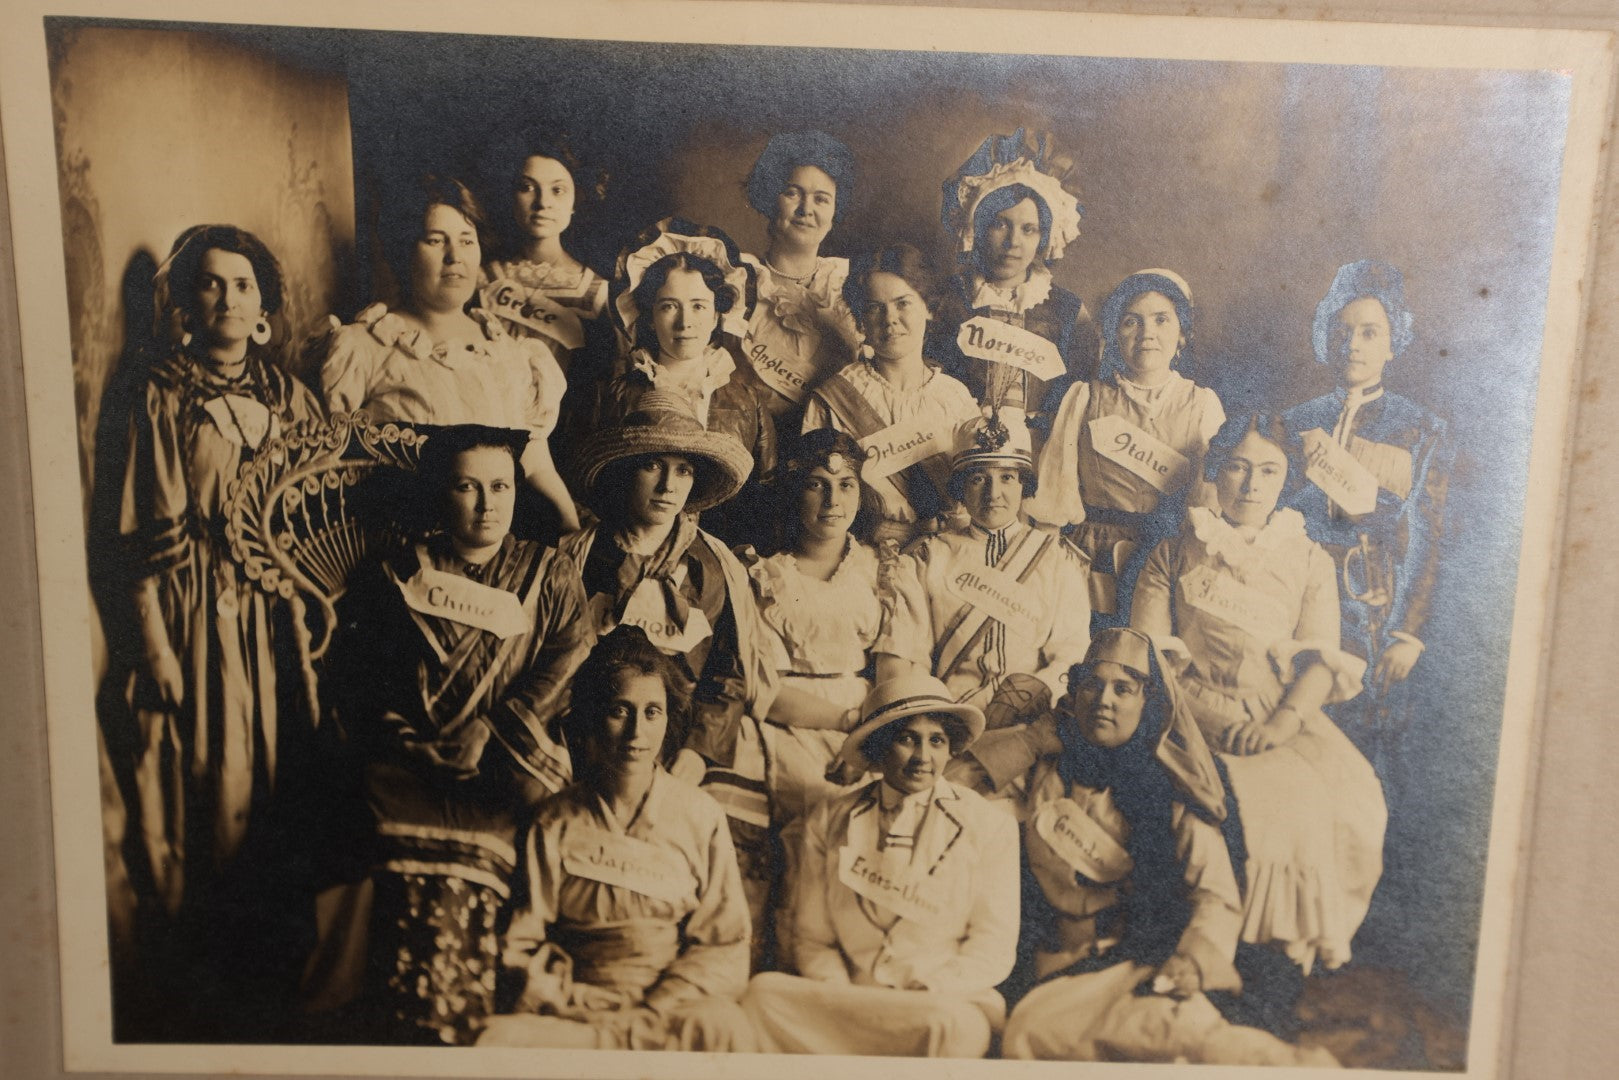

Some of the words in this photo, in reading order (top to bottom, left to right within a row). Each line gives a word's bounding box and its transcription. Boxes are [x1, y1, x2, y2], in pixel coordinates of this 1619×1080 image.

[496, 286, 557, 324] Grce
[866, 431, 933, 470] Irlande
[1112, 432, 1168, 476] Italie
